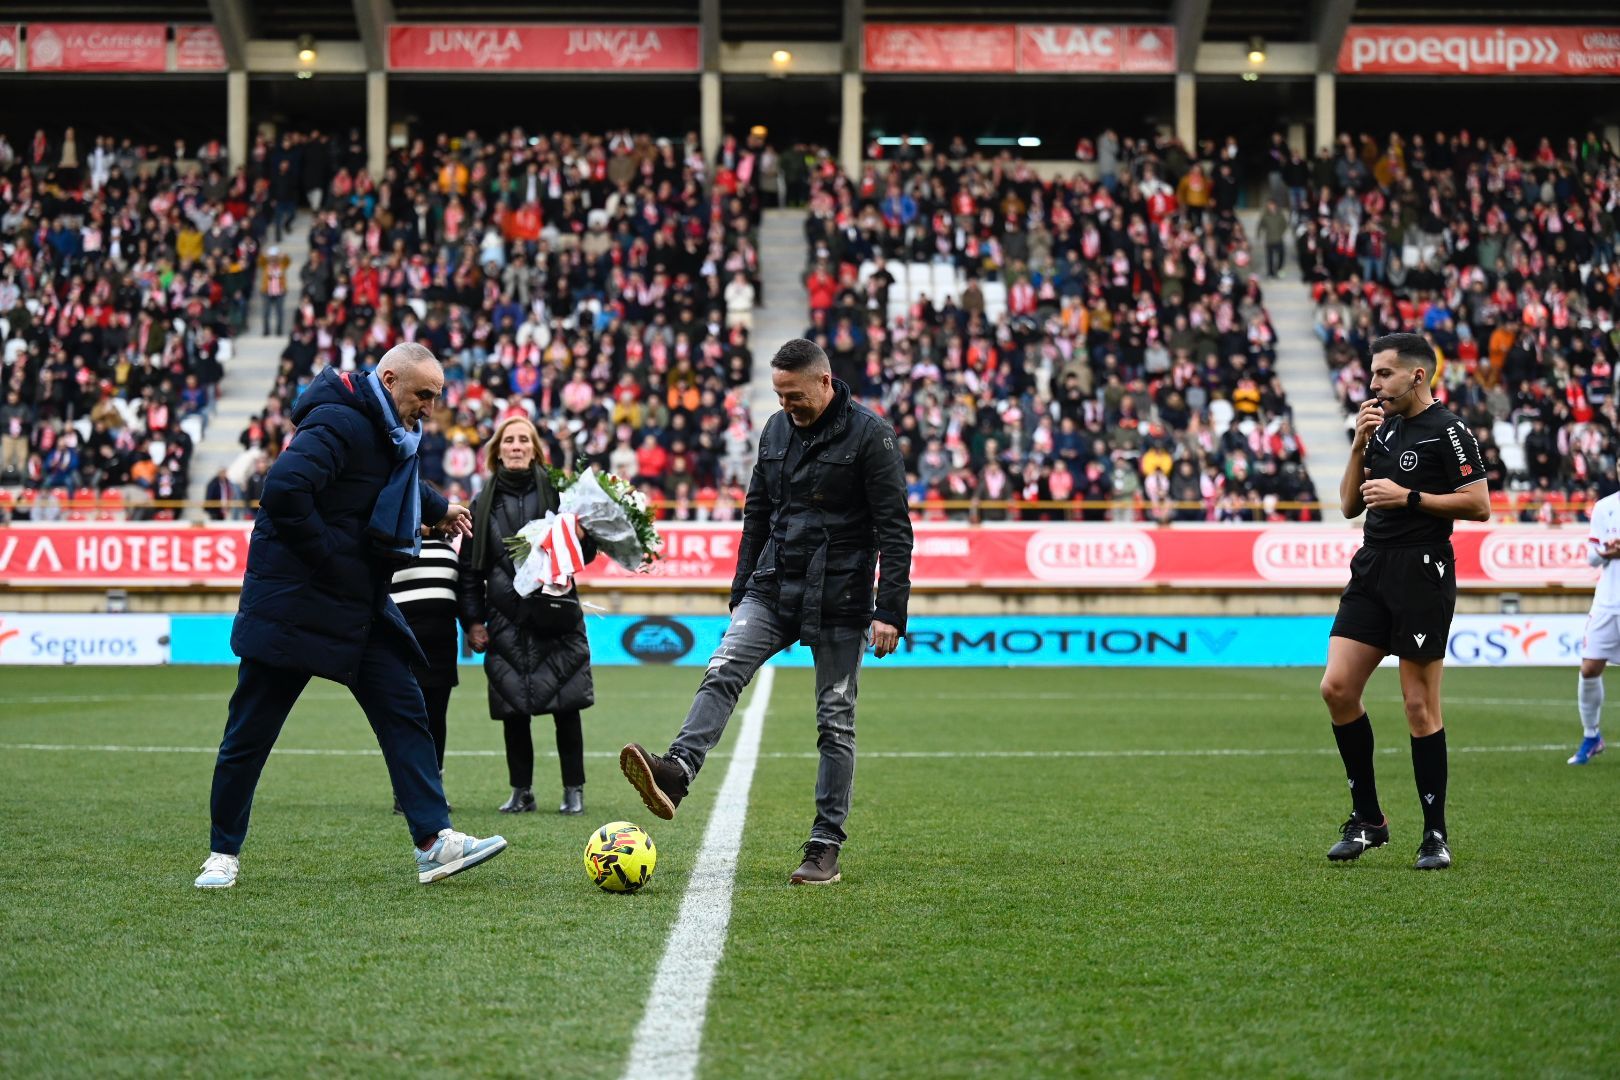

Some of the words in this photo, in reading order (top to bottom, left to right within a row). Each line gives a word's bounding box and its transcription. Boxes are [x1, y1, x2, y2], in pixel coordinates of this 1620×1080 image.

[424, 30, 523, 65] JUNGLA
[564, 30, 663, 65] JUNGLA
[1352, 30, 1532, 71] proequip
[76, 536, 237, 572] HOTELES
[667, 532, 733, 560] IRE
[1039, 542, 1138, 568] CERLESA
[30, 628, 136, 665] Seguros
[870, 628, 1188, 655] RMOTION
